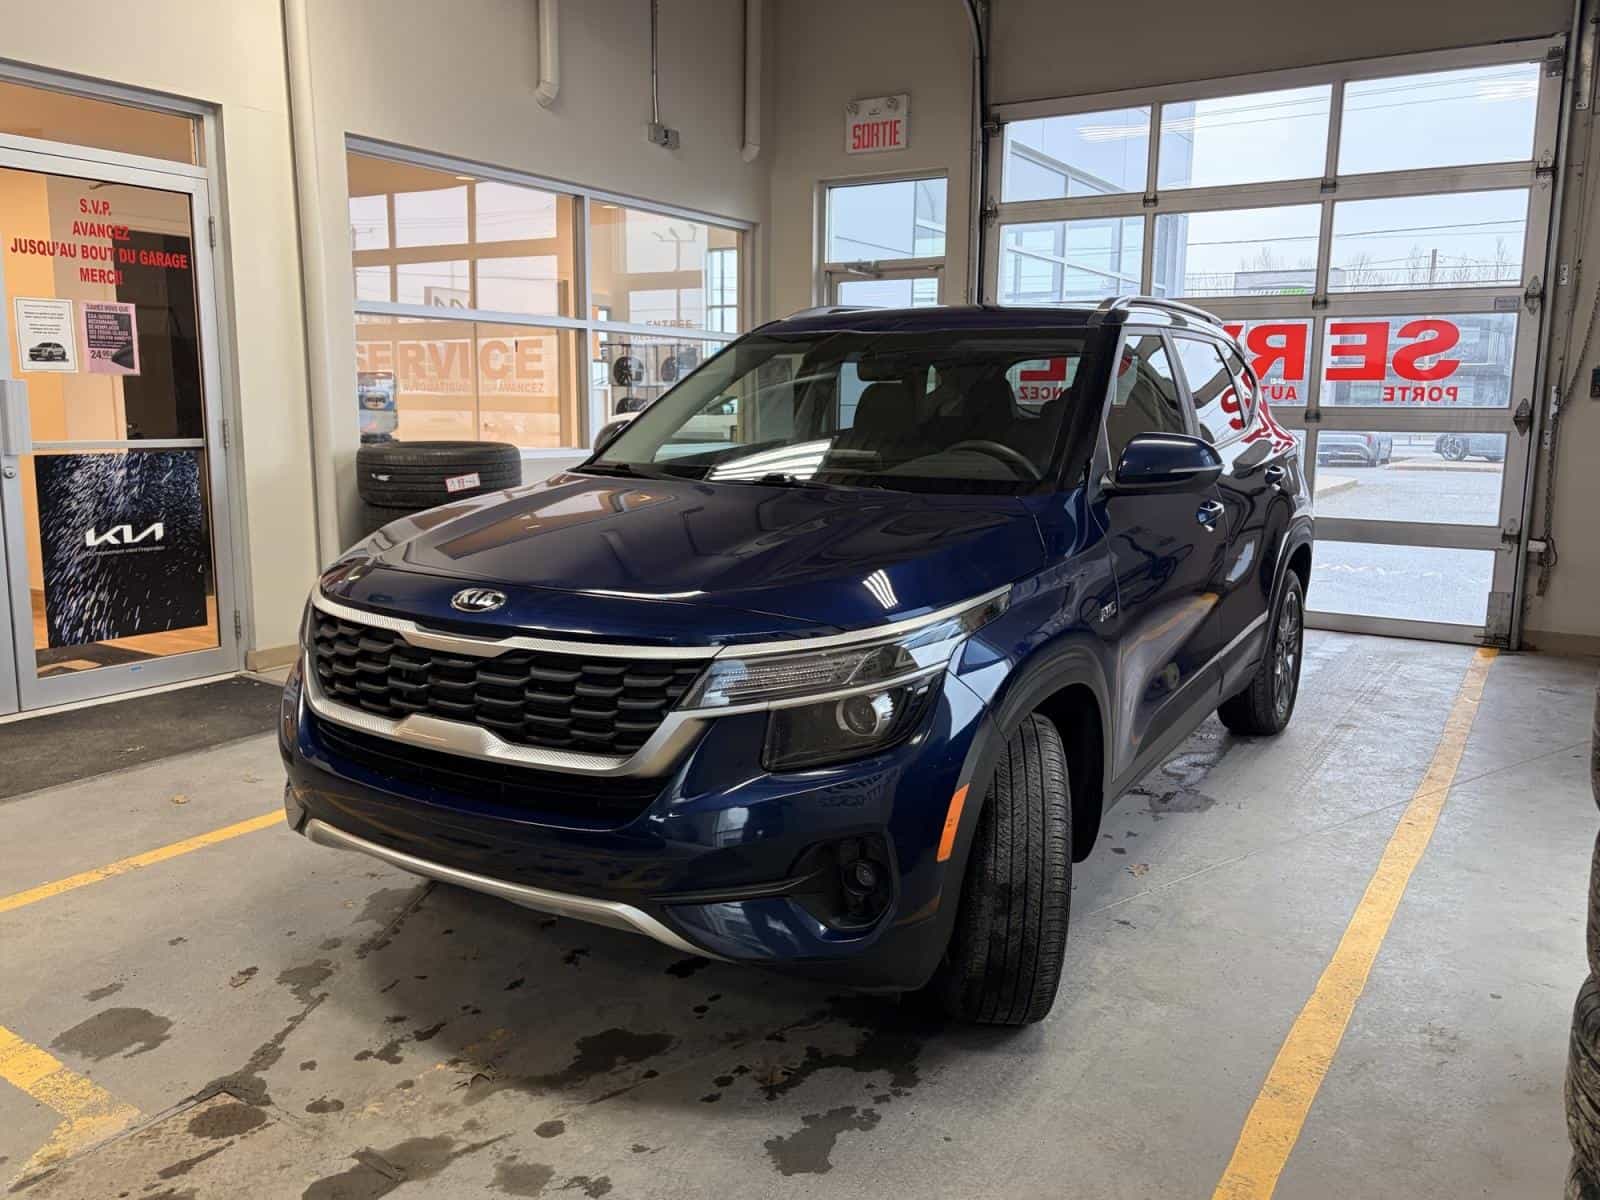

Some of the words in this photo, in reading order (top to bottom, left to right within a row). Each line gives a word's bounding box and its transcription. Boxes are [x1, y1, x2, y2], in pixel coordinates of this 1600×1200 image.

[852, 119, 902, 150] SORTIE
[80, 198, 112, 216] S.V.P.
[72, 221, 130, 240] AVANCEZ
[10, 238, 77, 258] JUSQU'AU
[81, 245, 114, 261] BOUT
[119, 248, 136, 264] DU
[140, 249, 188, 269] GARAGE
[86, 522, 164, 547] KIA
